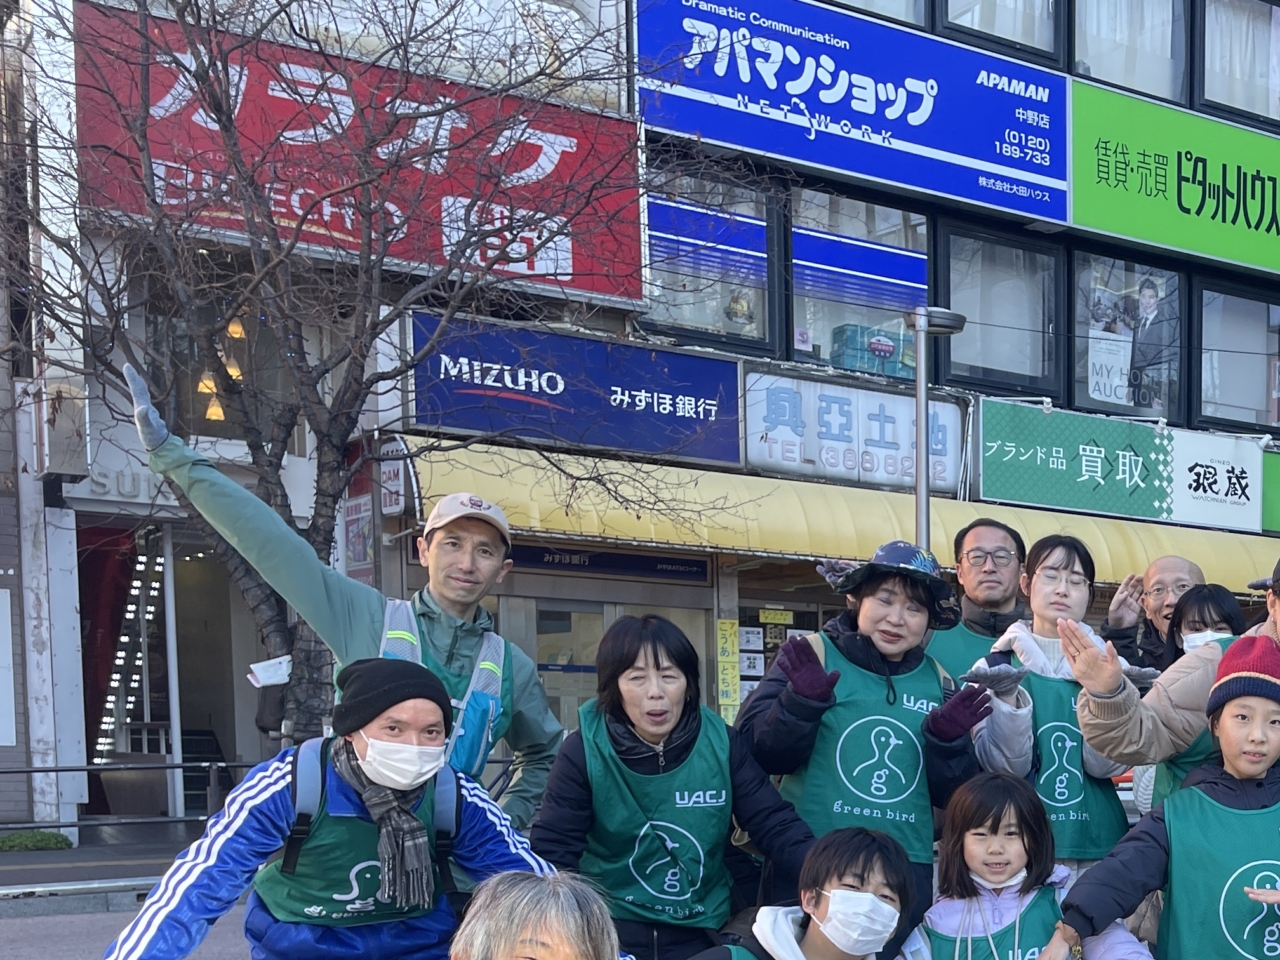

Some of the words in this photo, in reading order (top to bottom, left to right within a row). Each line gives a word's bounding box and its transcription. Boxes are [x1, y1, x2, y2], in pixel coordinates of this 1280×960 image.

[681, 0, 747, 22] Dramatic
[749, 11, 850, 50] Communication
[682, 17, 939, 127] アパマンショップ
[976, 70, 1050, 103] APAMAN
[1015, 107, 1051, 129] 中野店
[994, 141, 1051, 166] 189-733
[1004, 128, 1051, 153] (0120)
[978, 175, 1051, 202] 株式会社大田ハウス
[1176, 150, 1280, 237] ピタットハウス
[439, 353, 566, 395] MIZUHO
[1091, 361, 1114, 379] MY
[610, 386, 718, 421] みずほ銀行
[381, 468, 400, 484] DAM
[984, 440, 1067, 470] ブランド品
[1076, 444, 1147, 489] 買取
[1187, 461, 1251, 502] 銀蔵
[543, 553, 590, 566] みずほ銀行
[719, 621, 731, 658] こうあ
[902, 693, 940, 714] UAC
[675, 789, 727, 808] UACJ
[833, 800, 883, 818] green
[886, 808, 916, 823] bird
